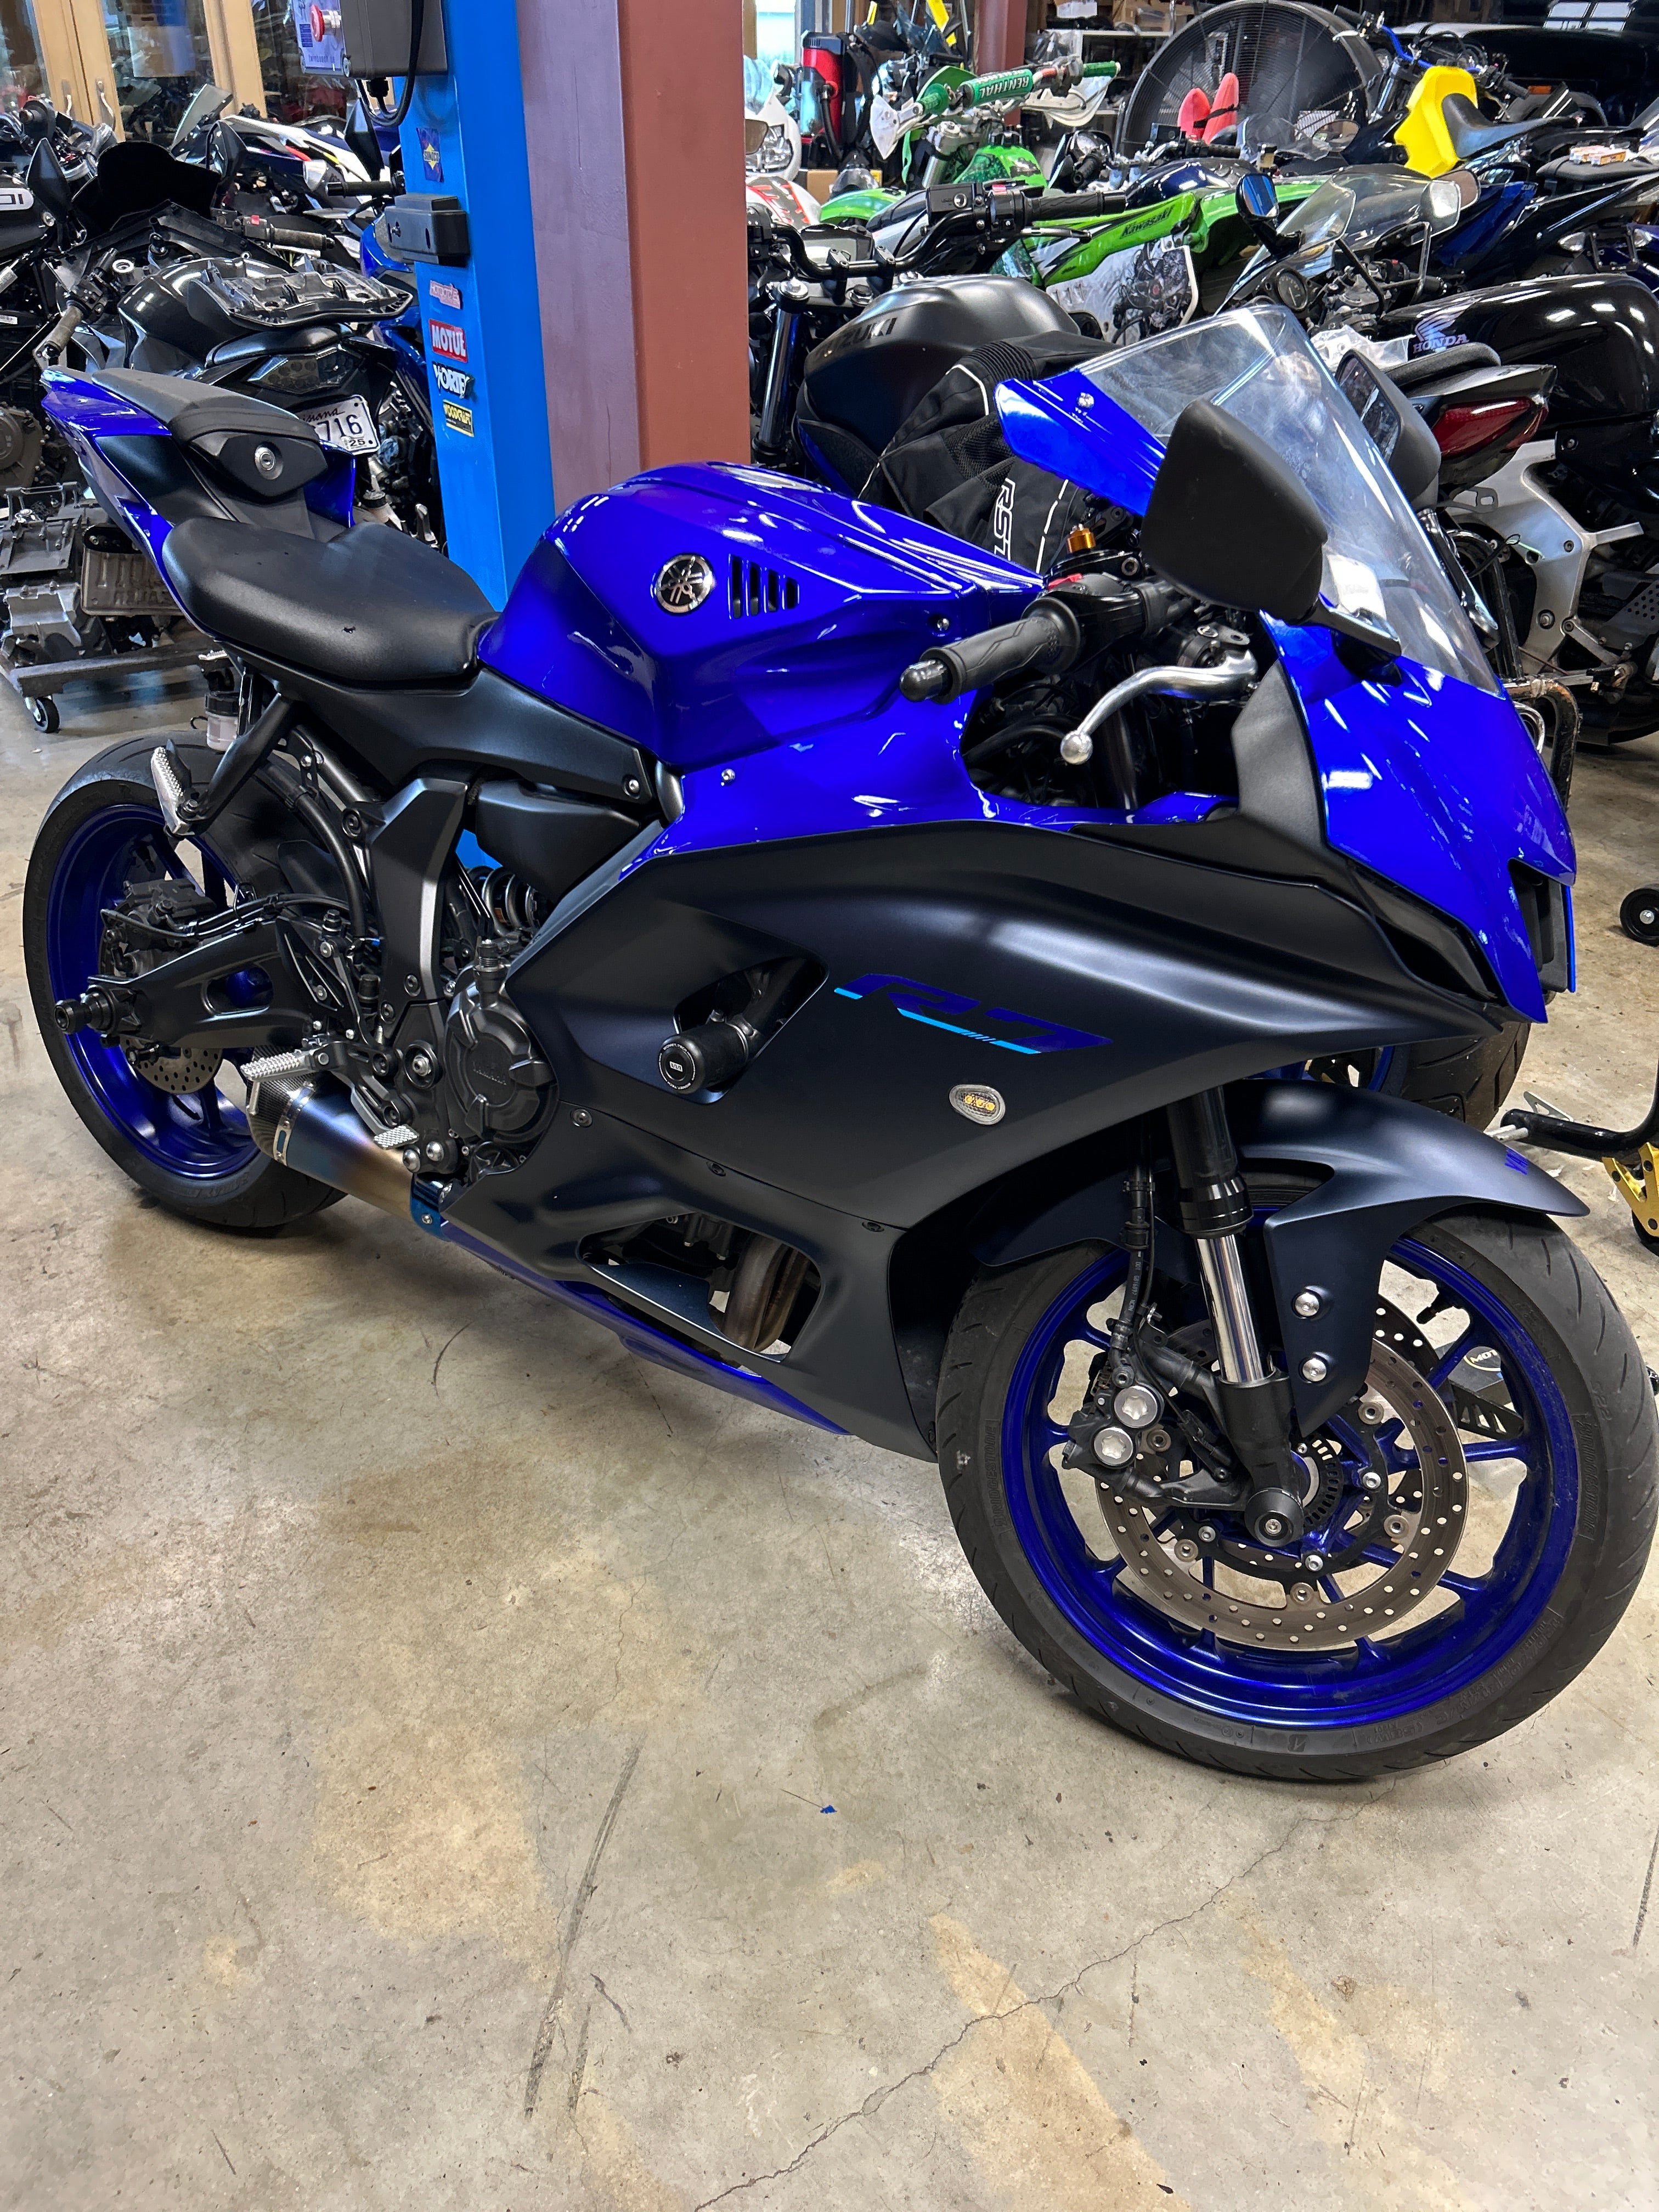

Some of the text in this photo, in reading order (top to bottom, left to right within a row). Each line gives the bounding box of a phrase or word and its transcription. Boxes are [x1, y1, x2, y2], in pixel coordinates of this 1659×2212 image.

[979, 76, 1029, 98] RENTHAL
[1119, 203, 1175, 239] Kawasaki
[431, 324, 466, 357] MOTUL
[1413, 334, 1469, 354] HONDA
[349, 438, 365, 447] 25
[834, 973, 1113, 1054] R7
